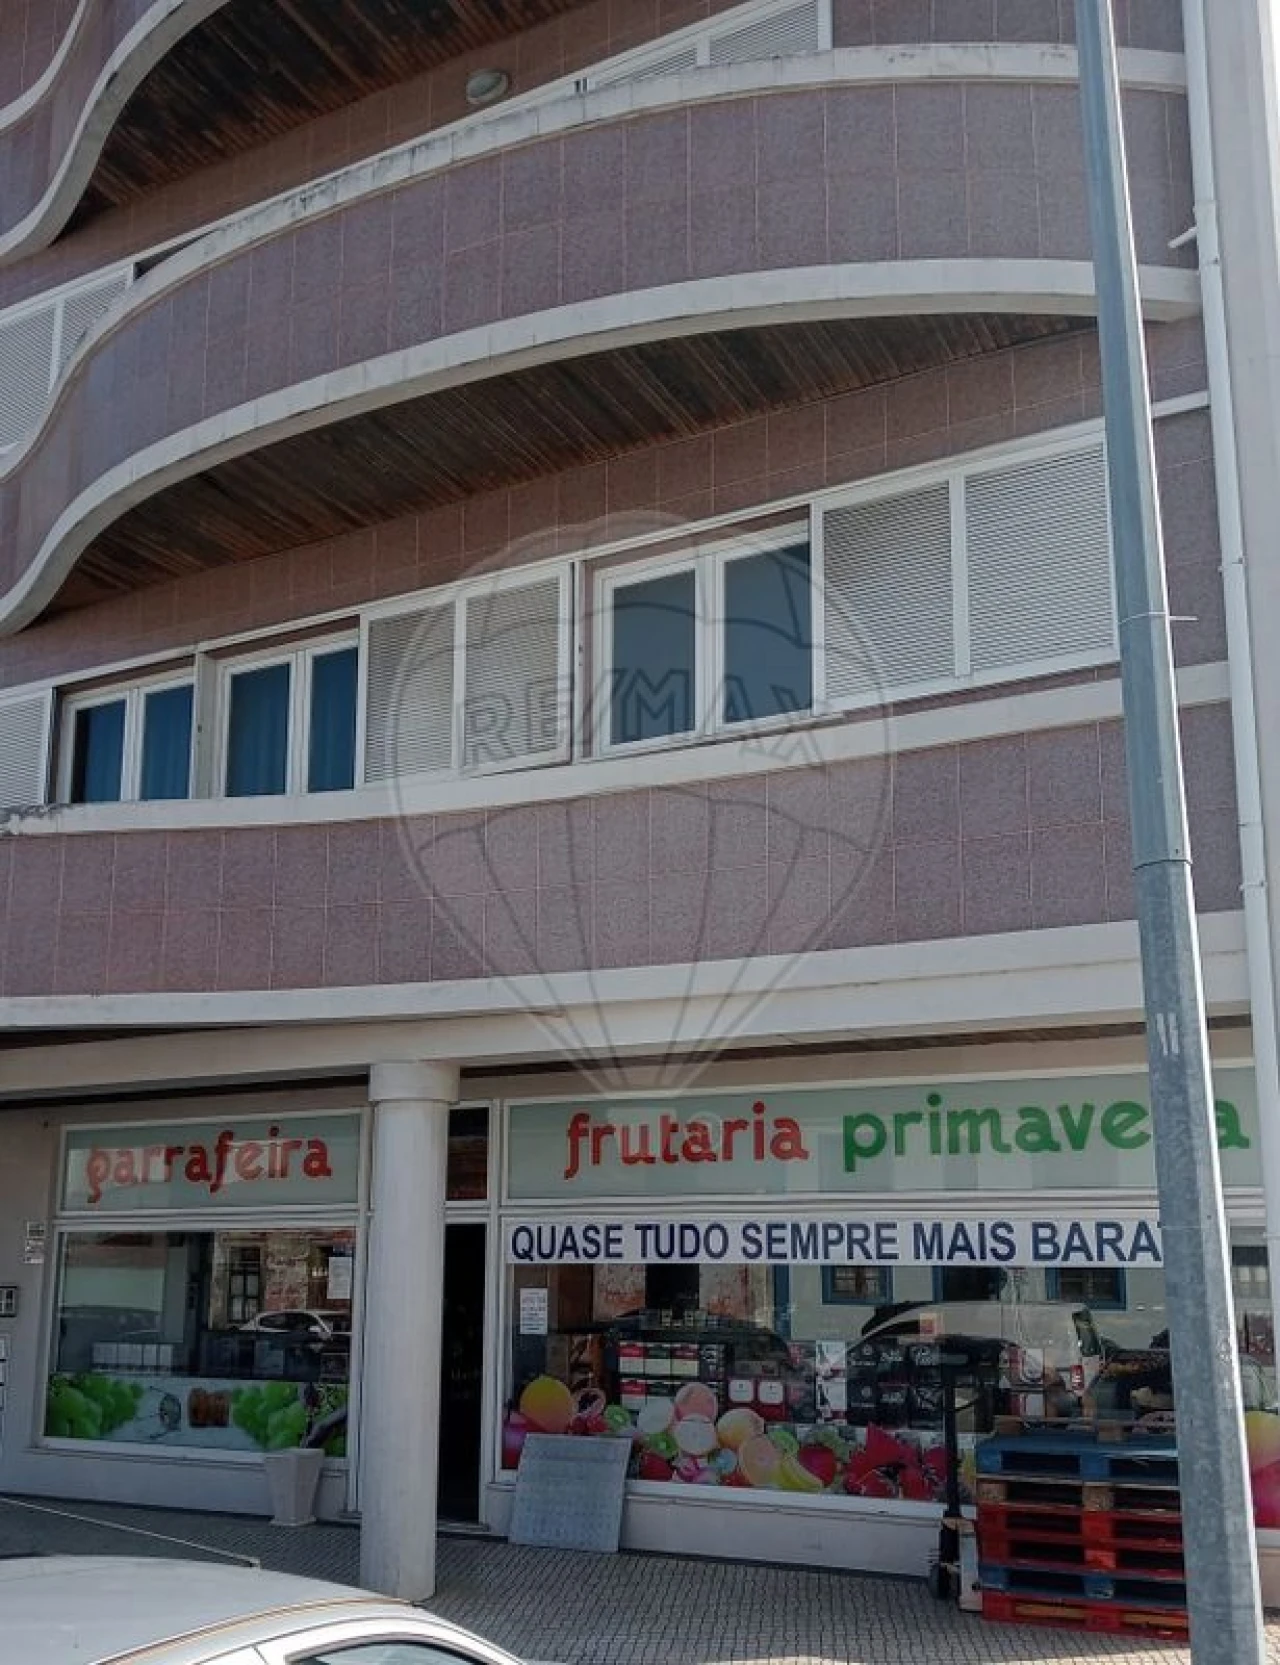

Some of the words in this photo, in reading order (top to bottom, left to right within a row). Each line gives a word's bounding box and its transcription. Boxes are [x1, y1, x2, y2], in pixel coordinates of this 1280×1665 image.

[564, 1100, 809, 1180] frutaria
[842, 1093, 1250, 1172] primavea
[511, 1224, 624, 1262] QUASE
[635, 1223, 729, 1261] TUDO
[741, 1222, 900, 1261] SEMPRE
[913, 1221, 1017, 1262] MAIS
[1031, 1219, 1163, 1262] BARA
